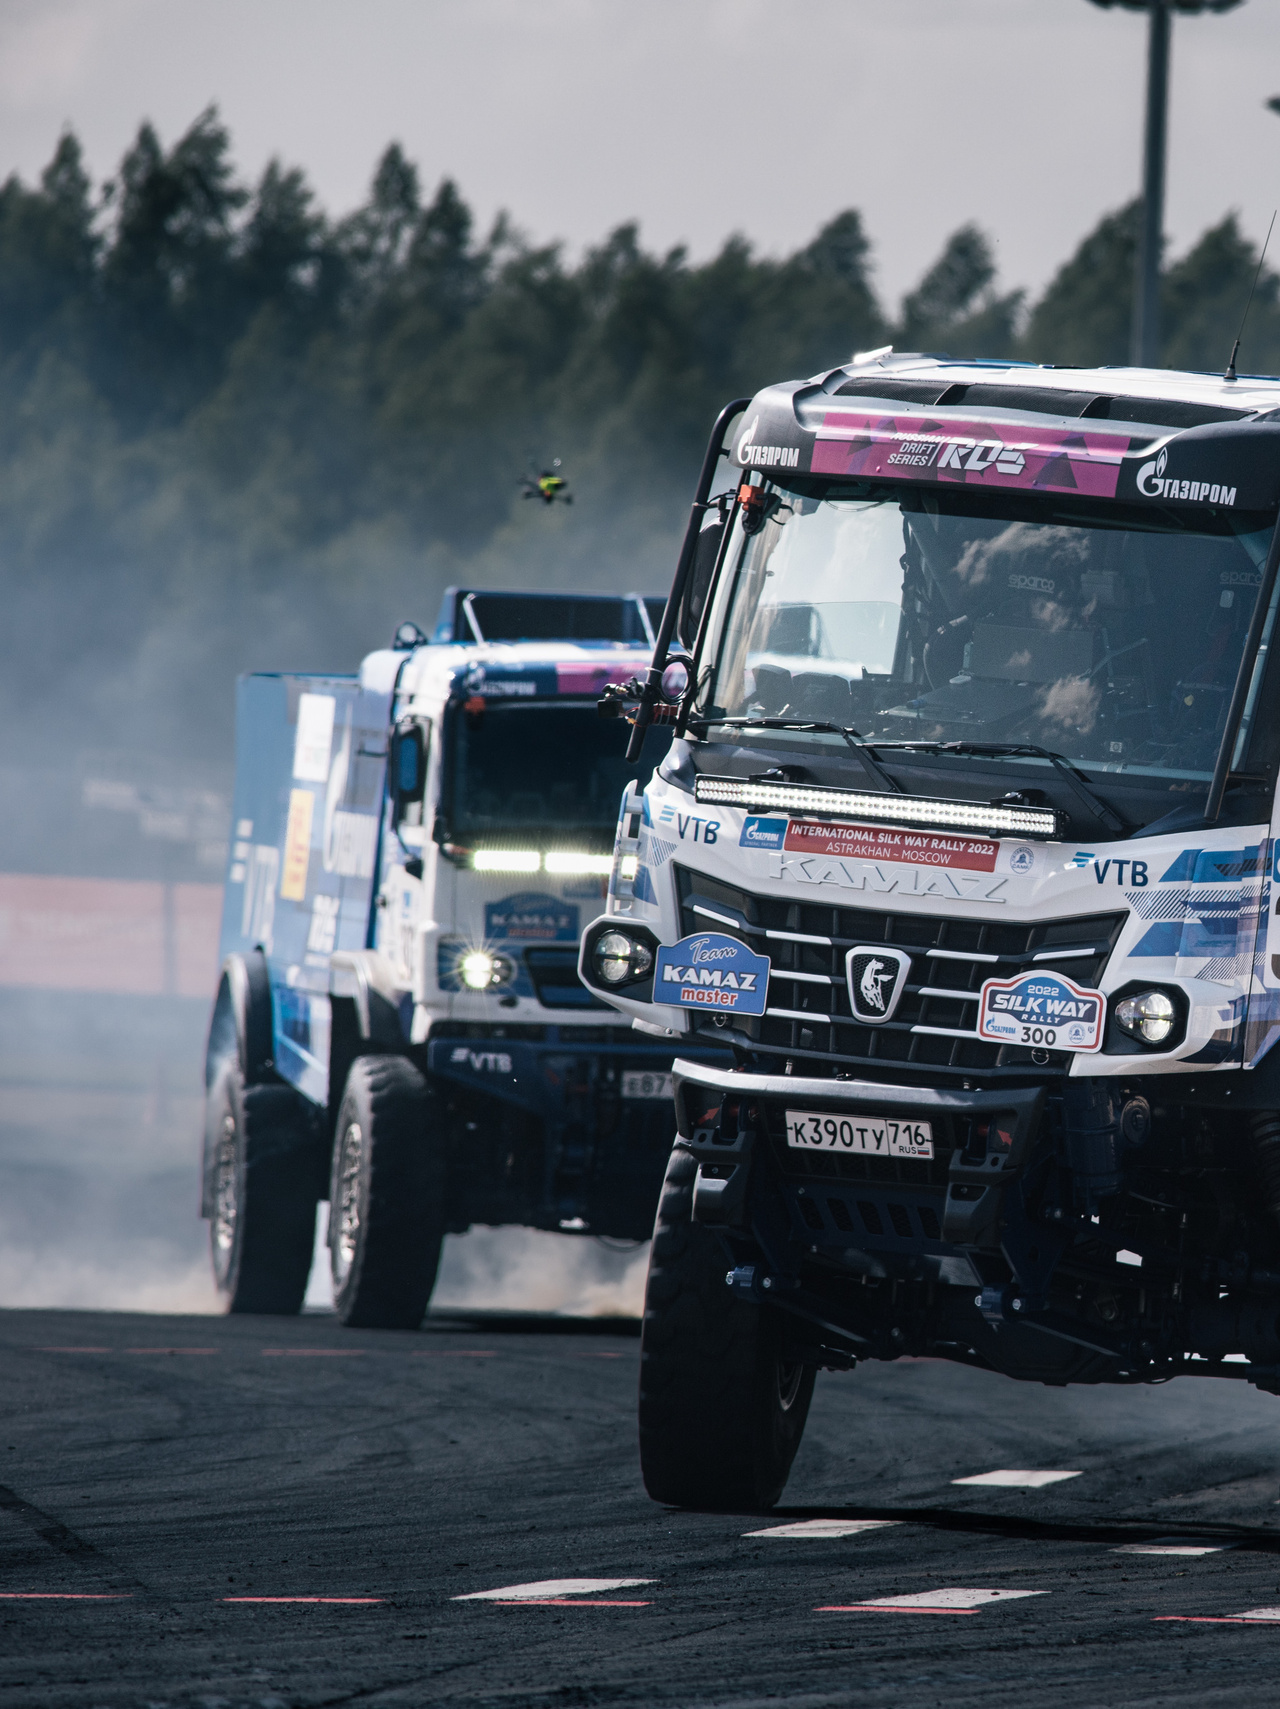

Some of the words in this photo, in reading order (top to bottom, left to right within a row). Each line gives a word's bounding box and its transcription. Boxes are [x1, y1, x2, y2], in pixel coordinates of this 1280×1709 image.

[750, 447, 799, 468] ГАЗПРОМ
[887, 452, 929, 467] SERIES
[898, 442, 935, 455] DRIFT
[937, 437, 1039, 475] RDS
[1163, 478, 1237, 506] ГАЗПРОМ
[1008, 573, 1055, 592] sparco
[677, 813, 721, 845] VTB
[754, 832, 779, 842] GAZPROM
[791, 824, 876, 843] INTERNATIONAL
[877, 832, 902, 846] SILK
[904, 835, 930, 848] WAY
[931, 838, 966, 853] RALLY
[967, 843, 995, 856] 2022
[825, 841, 891, 858] ASTRAKHAN
[901, 848, 952, 865] MOSCOW
[768, 852, 1008, 903] KAMAZ
[1094, 857, 1148, 888] VTB
[690, 938, 738, 964] Team
[662, 964, 757, 992] KAMAZ
[681, 987, 738, 1006] master
[1027, 985, 1059, 997] 2022
[992, 993, 1044, 1013] SILK
[1046, 999, 1092, 1018] WAY
[1021, 1013, 1061, 1023] RALLY
[994, 1025, 1016, 1034] GAZPROM
[1021, 1026, 1056, 1046] 300
[888, 1122, 927, 1146] 716
[899, 1146, 917, 1154] RUS
